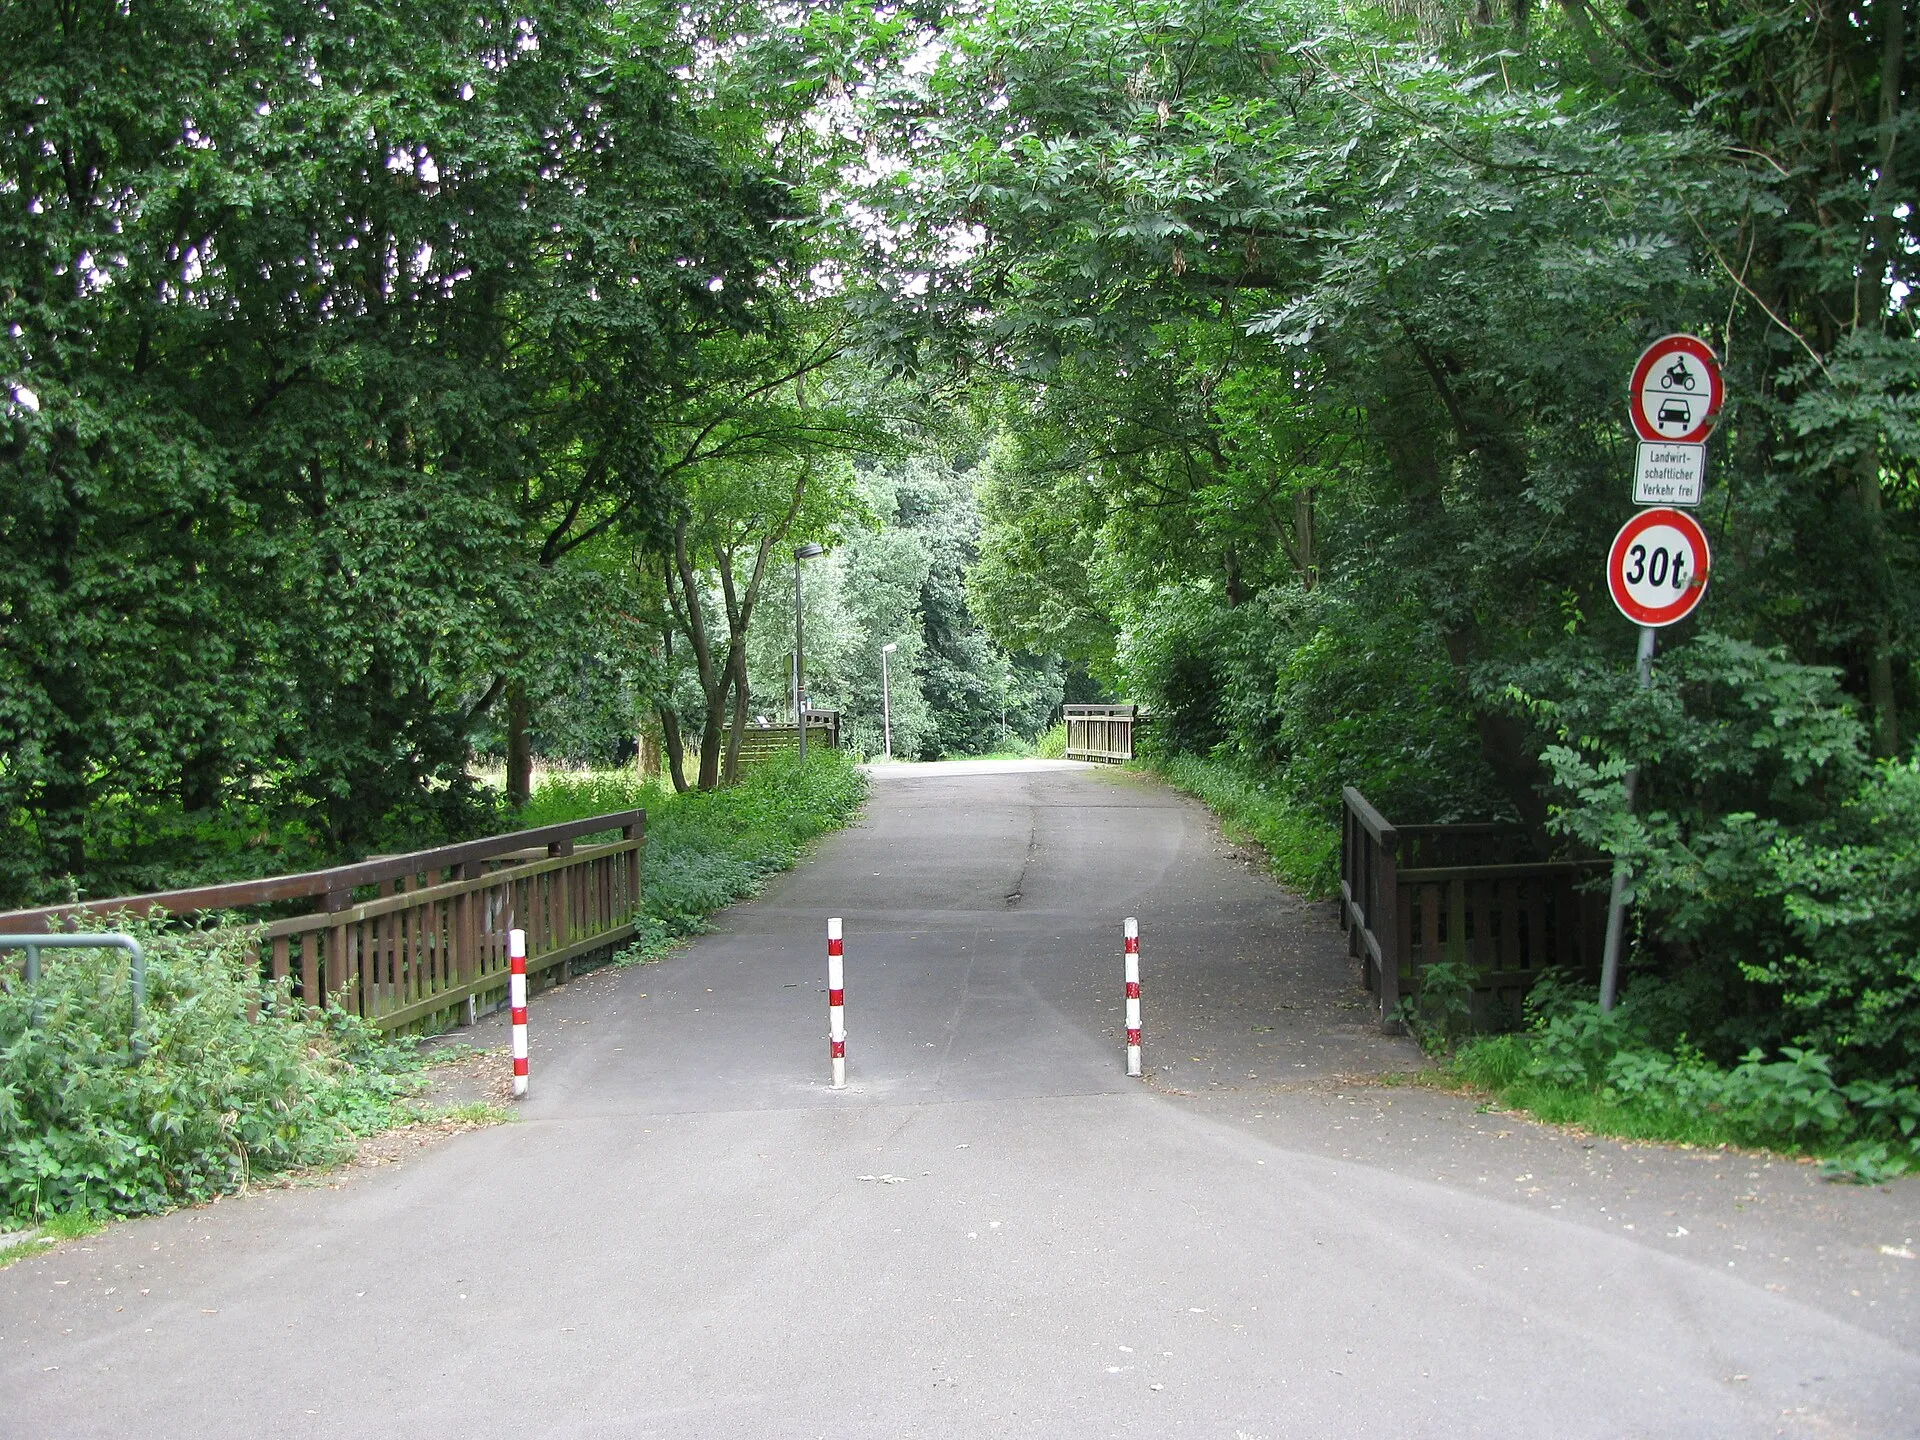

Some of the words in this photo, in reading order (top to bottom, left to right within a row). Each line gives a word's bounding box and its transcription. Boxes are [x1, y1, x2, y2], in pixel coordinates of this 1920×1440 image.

[1650, 451, 1691, 463] Landwirt-
[1645, 468, 1694, 480] schaftlicher
[1643, 483, 1674, 496] Verkehr
[1678, 484, 1693, 496] frei
[1626, 544, 1685, 589] 30t
